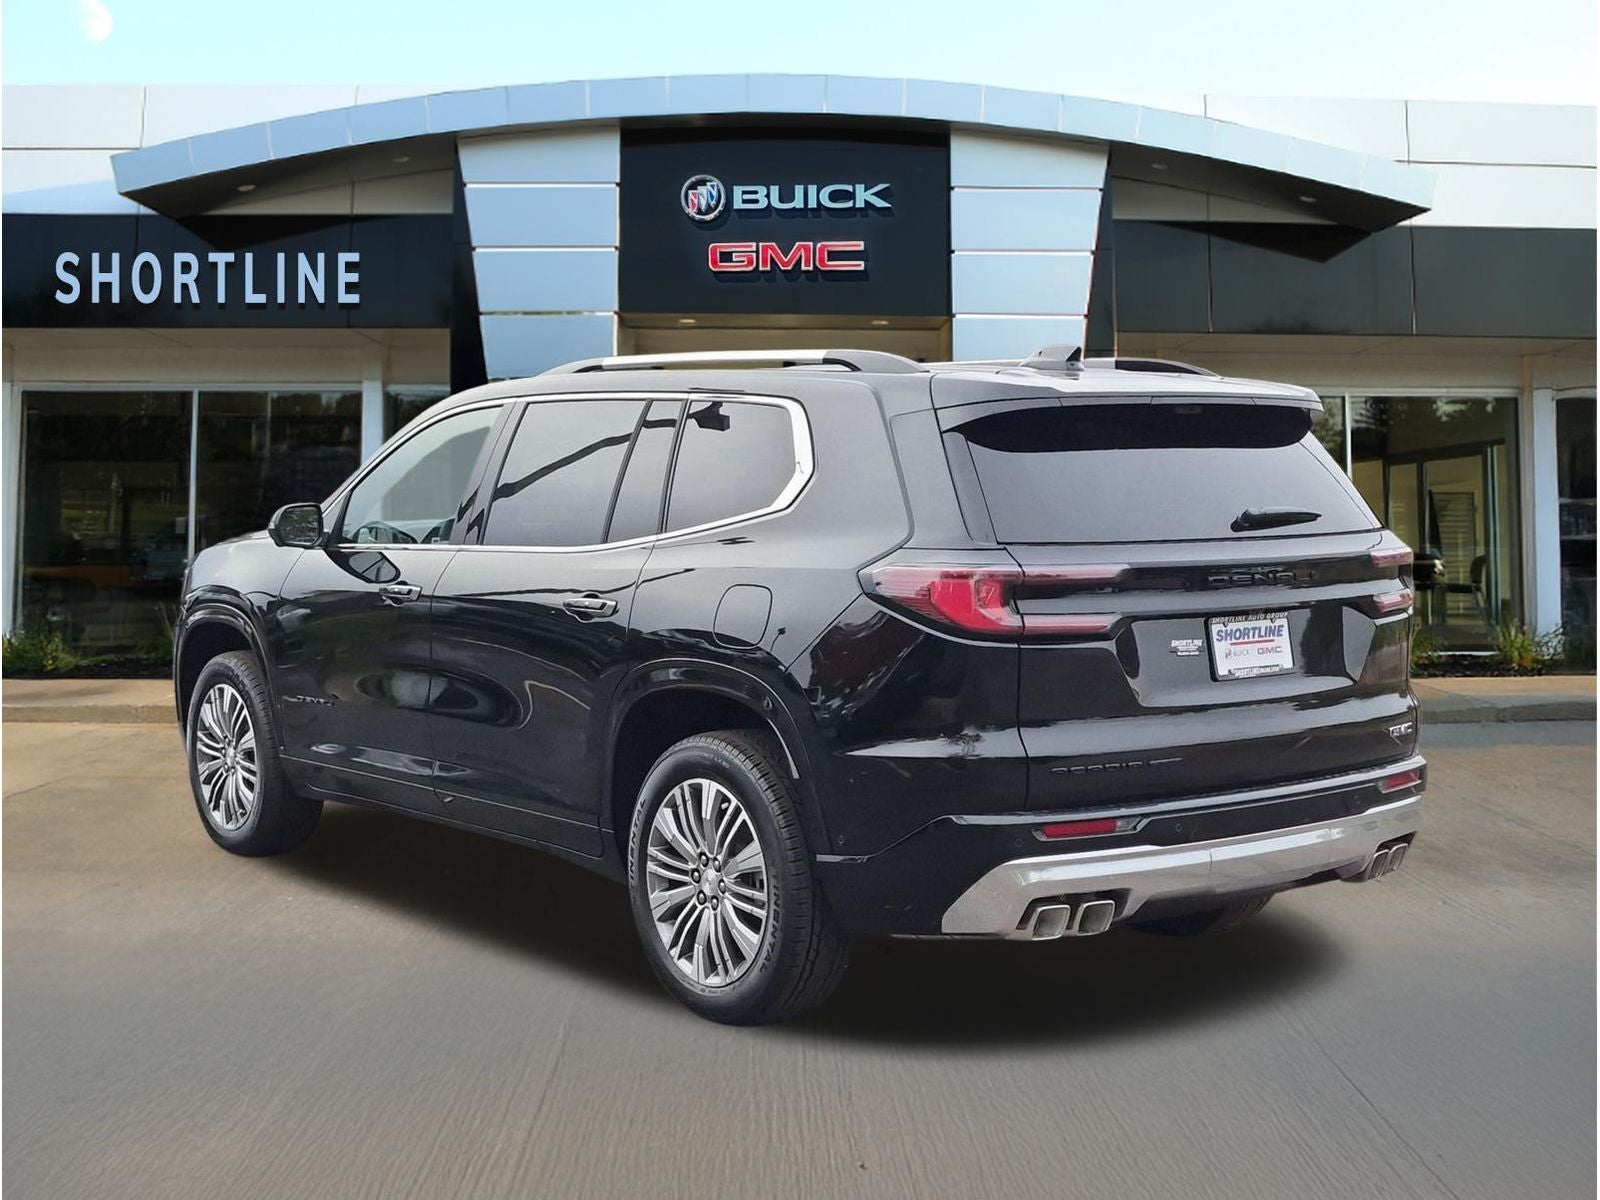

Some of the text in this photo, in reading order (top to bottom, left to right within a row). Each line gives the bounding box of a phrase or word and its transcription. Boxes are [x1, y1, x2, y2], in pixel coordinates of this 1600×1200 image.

[733, 183, 892, 210] BUICK
[708, 241, 865, 272] GMC
[55, 251, 360, 305] SHORTLINE
[1215, 624, 1285, 643] SHORTLINE
[1257, 645, 1283, 655] GMC
